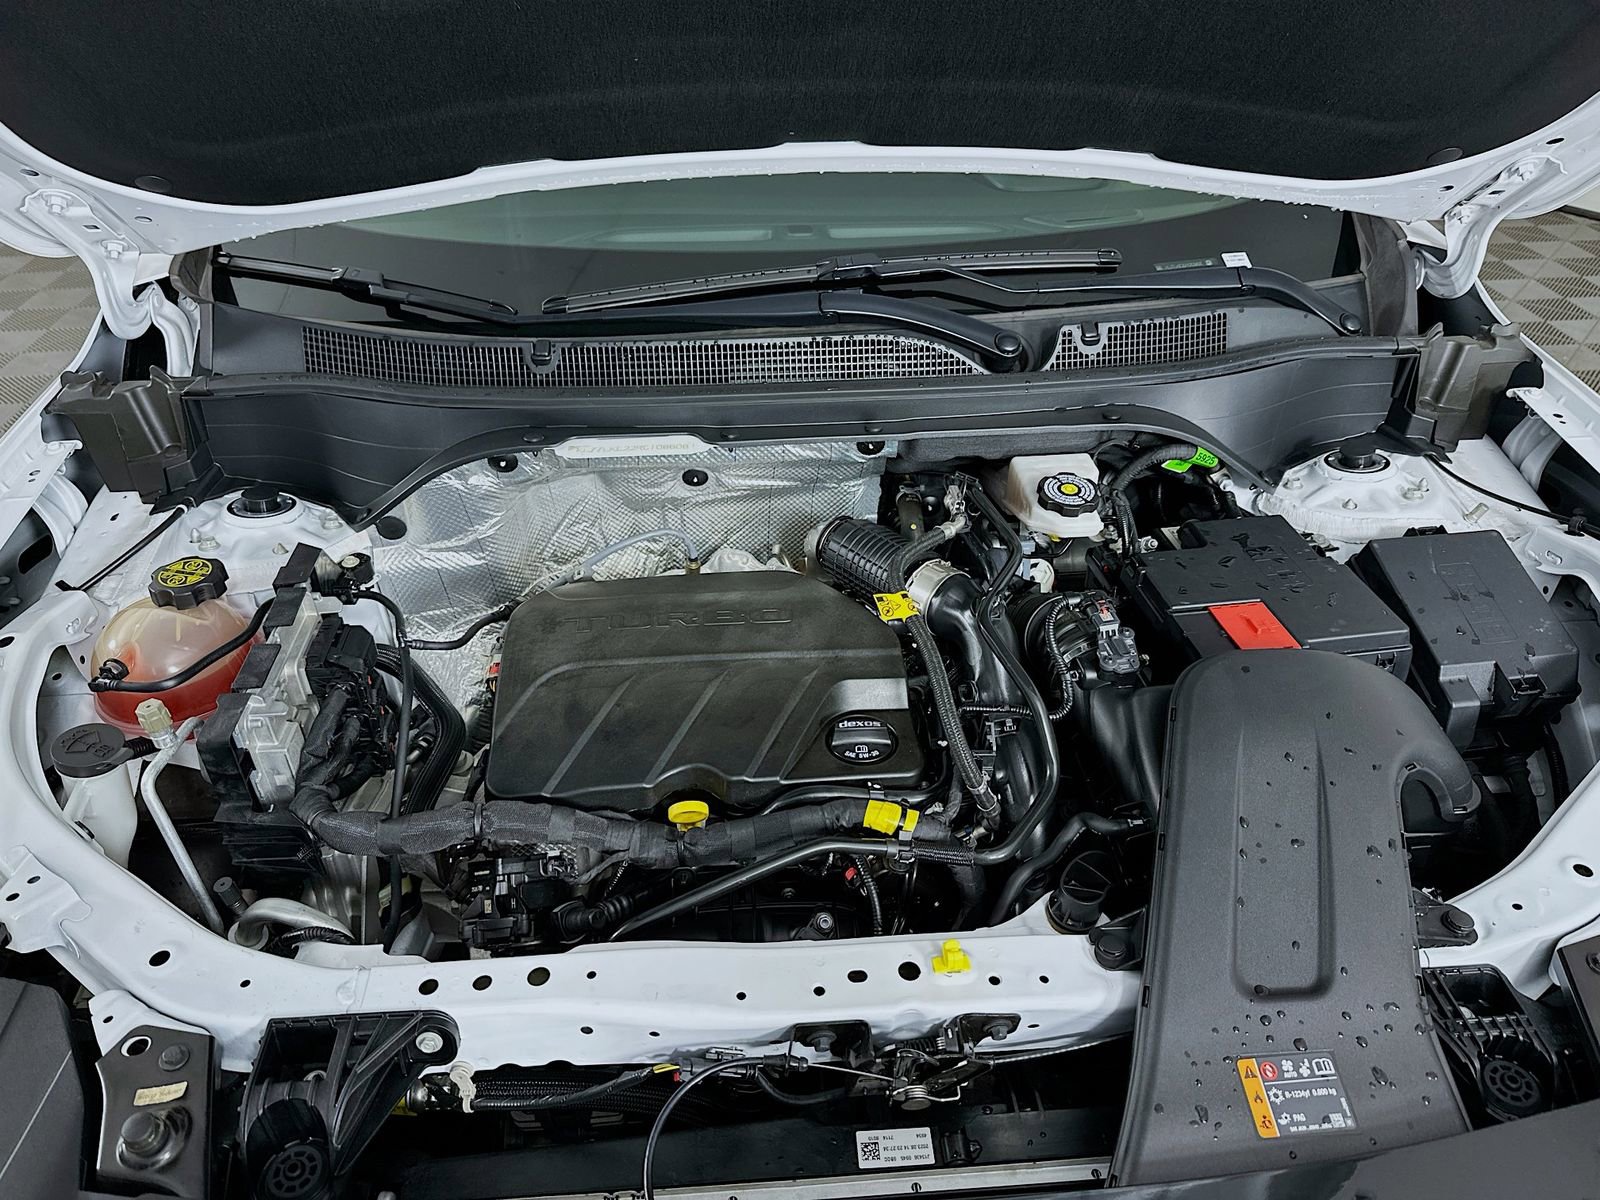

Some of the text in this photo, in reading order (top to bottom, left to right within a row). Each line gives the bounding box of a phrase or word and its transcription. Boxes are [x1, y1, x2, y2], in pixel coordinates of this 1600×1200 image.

[560, 608, 793, 633] TURBO
[838, 720, 881, 728] dexos
[844, 750, 857, 758] SAE
[1329, 1087, 1337, 1096] kg
